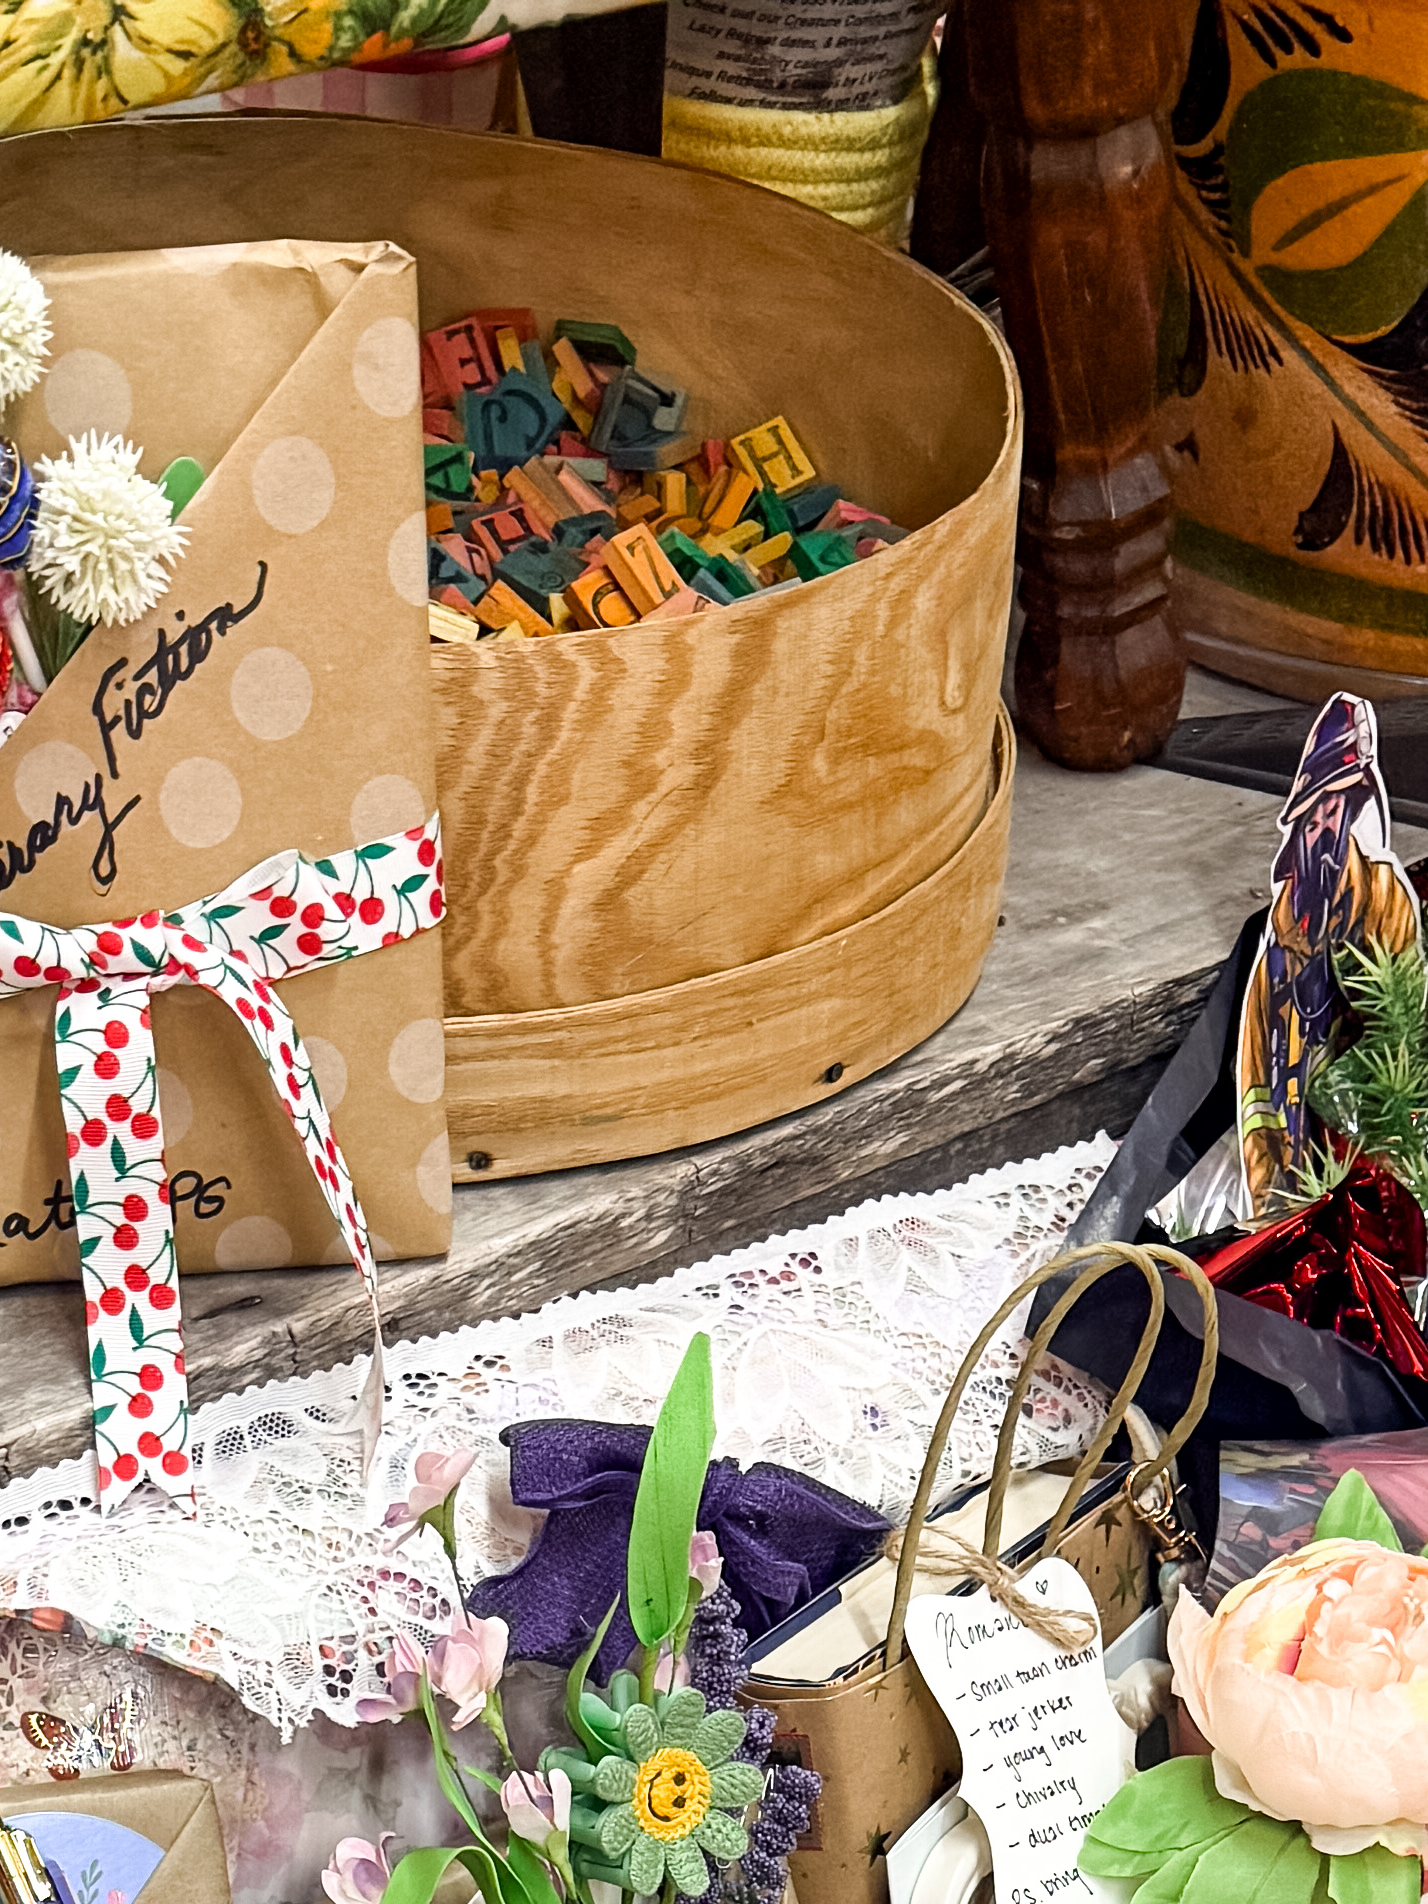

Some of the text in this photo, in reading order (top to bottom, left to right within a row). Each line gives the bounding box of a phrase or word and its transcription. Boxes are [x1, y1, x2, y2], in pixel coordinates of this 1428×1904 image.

[739, 424, 804, 490] H
[92, 559, 268, 778] Fiction
[970, 1673, 1013, 1703] Small
[988, 1710, 1019, 1738] tear
[1003, 1729, 1087, 1782] young love
